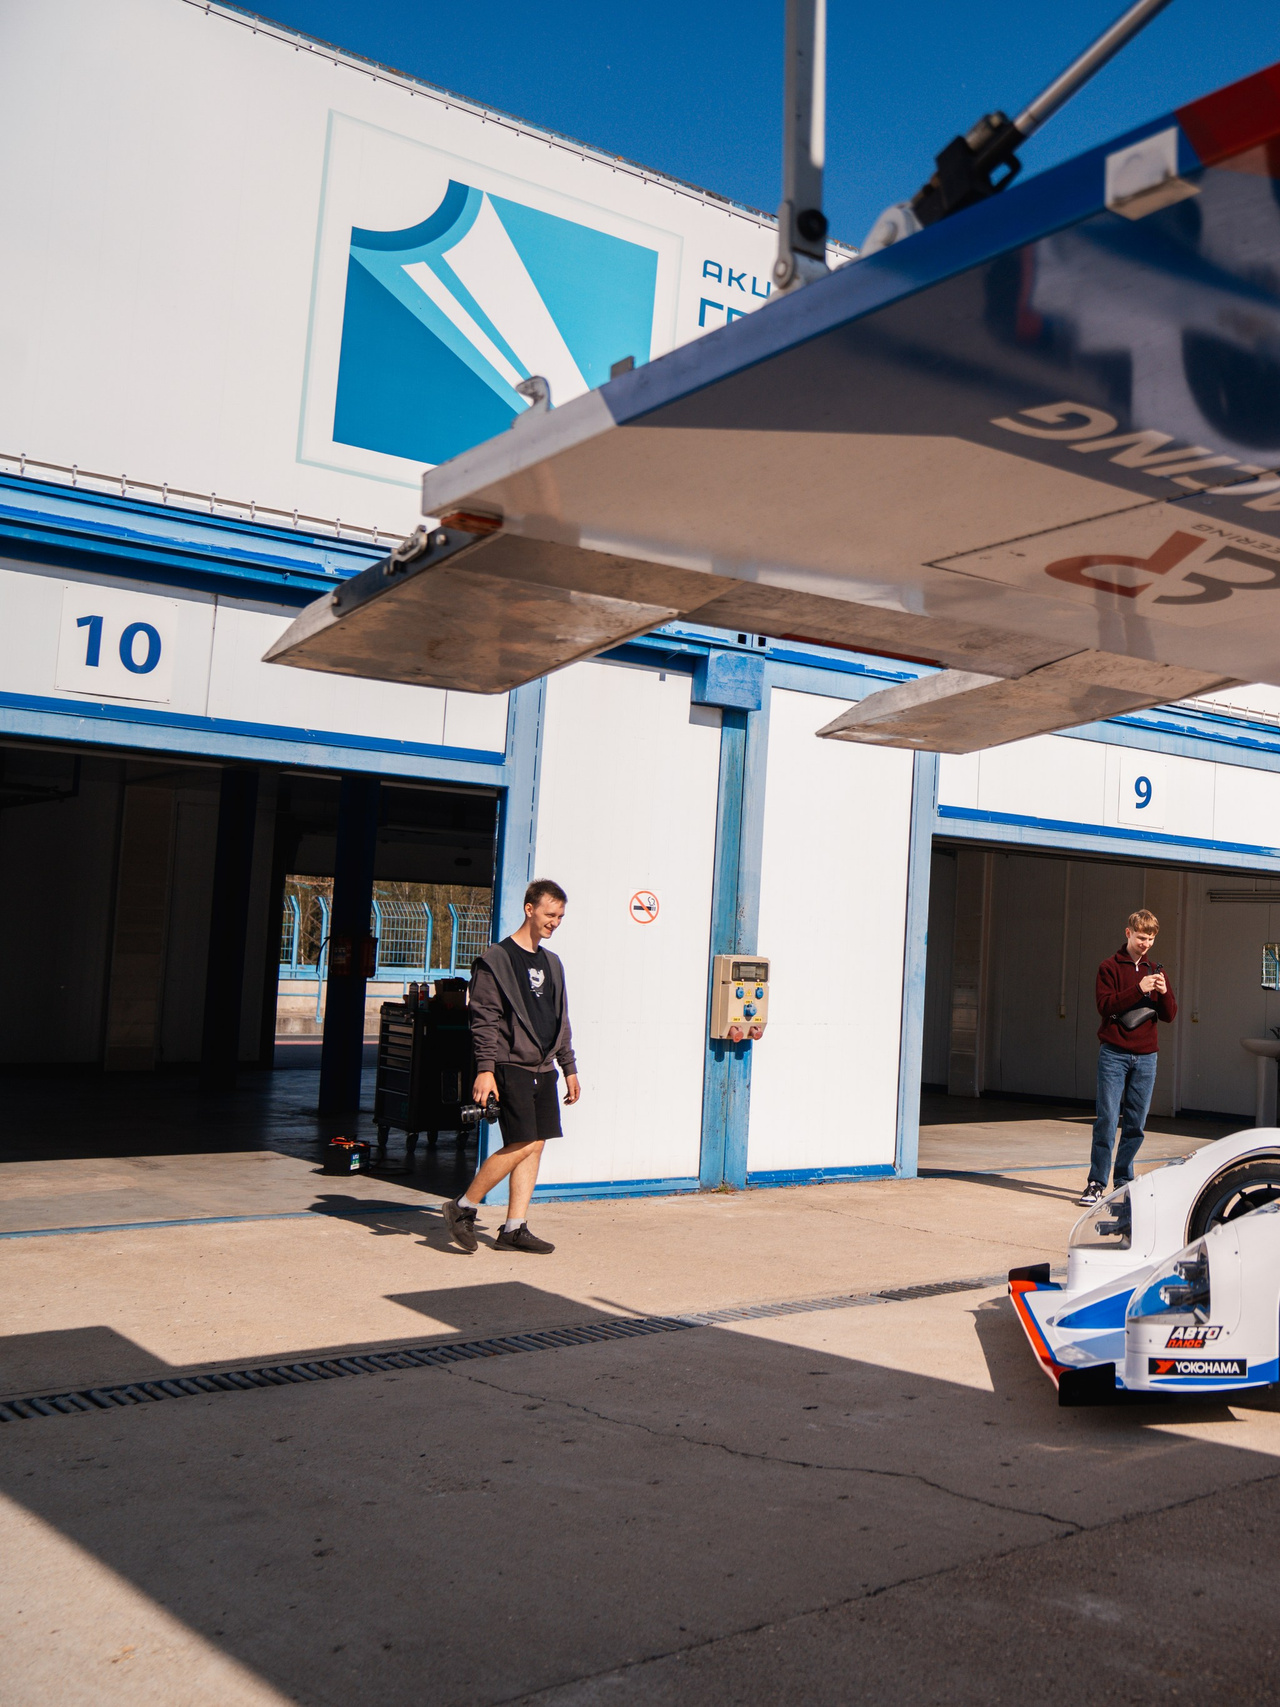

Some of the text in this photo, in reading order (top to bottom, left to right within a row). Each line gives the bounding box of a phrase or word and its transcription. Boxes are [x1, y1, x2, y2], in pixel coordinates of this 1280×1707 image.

[76, 614, 162, 675] 10
[1134, 775, 1153, 809] 9
[1171, 1326, 1221, 1340] АВТО
[1167, 1339, 1203, 1348] ПЛЮС
[1175, 1361, 1240, 1374] YOKOHAMA
